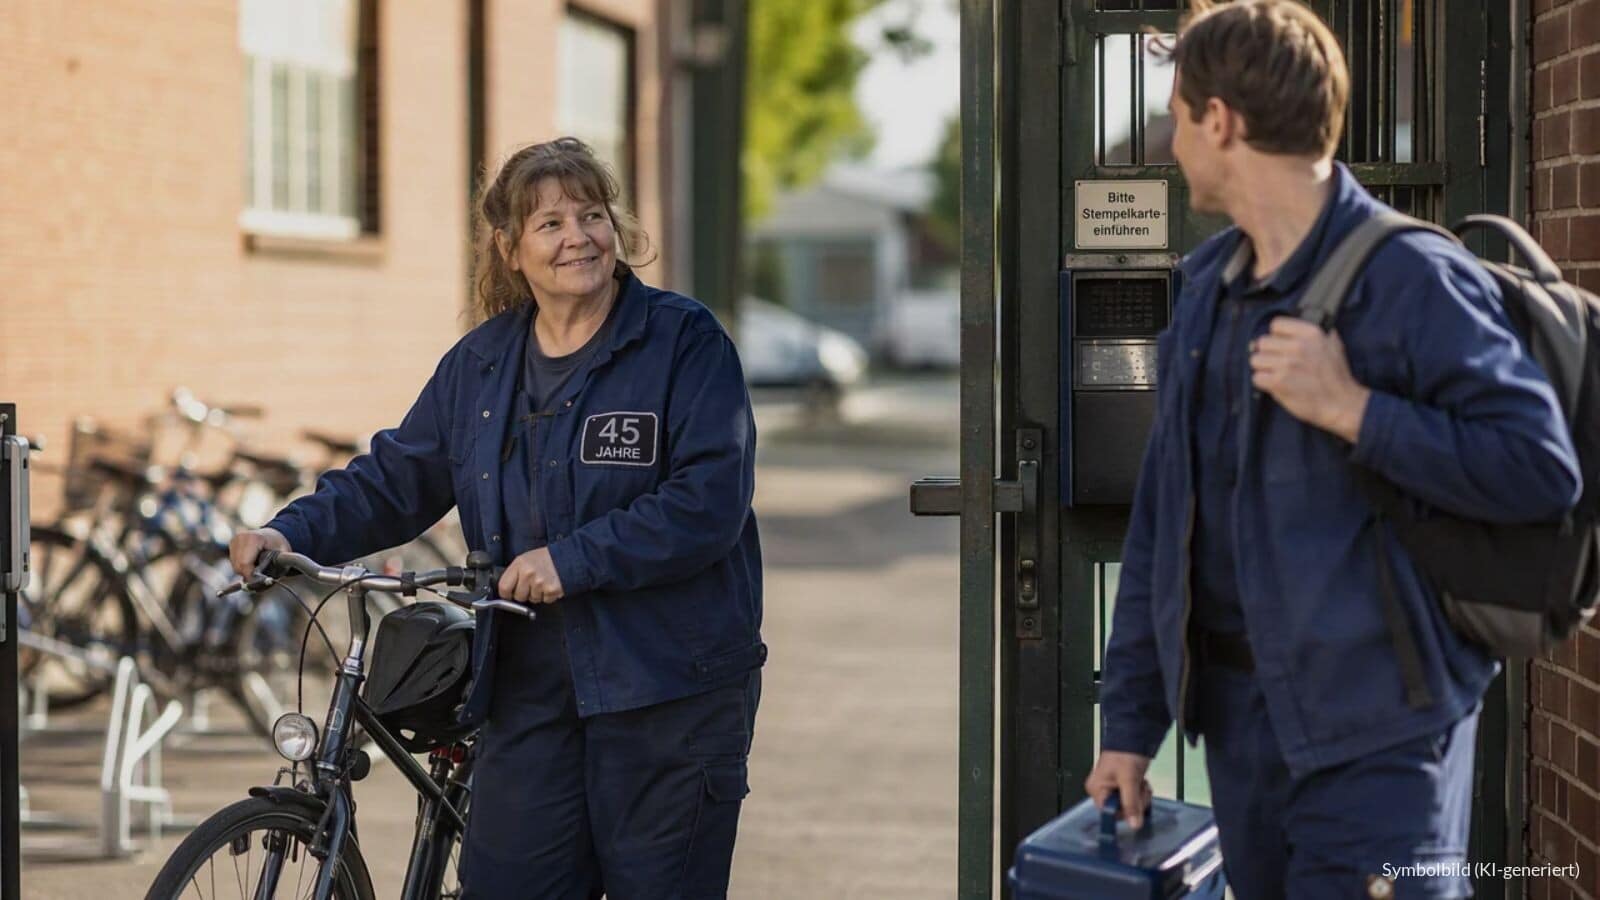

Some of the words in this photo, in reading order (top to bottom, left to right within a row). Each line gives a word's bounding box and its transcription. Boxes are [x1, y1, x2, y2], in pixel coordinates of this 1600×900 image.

[1108, 192, 1135, 203] Bitte
[598, 417, 640, 445] 45
[595, 446, 641, 459] JAHRE
